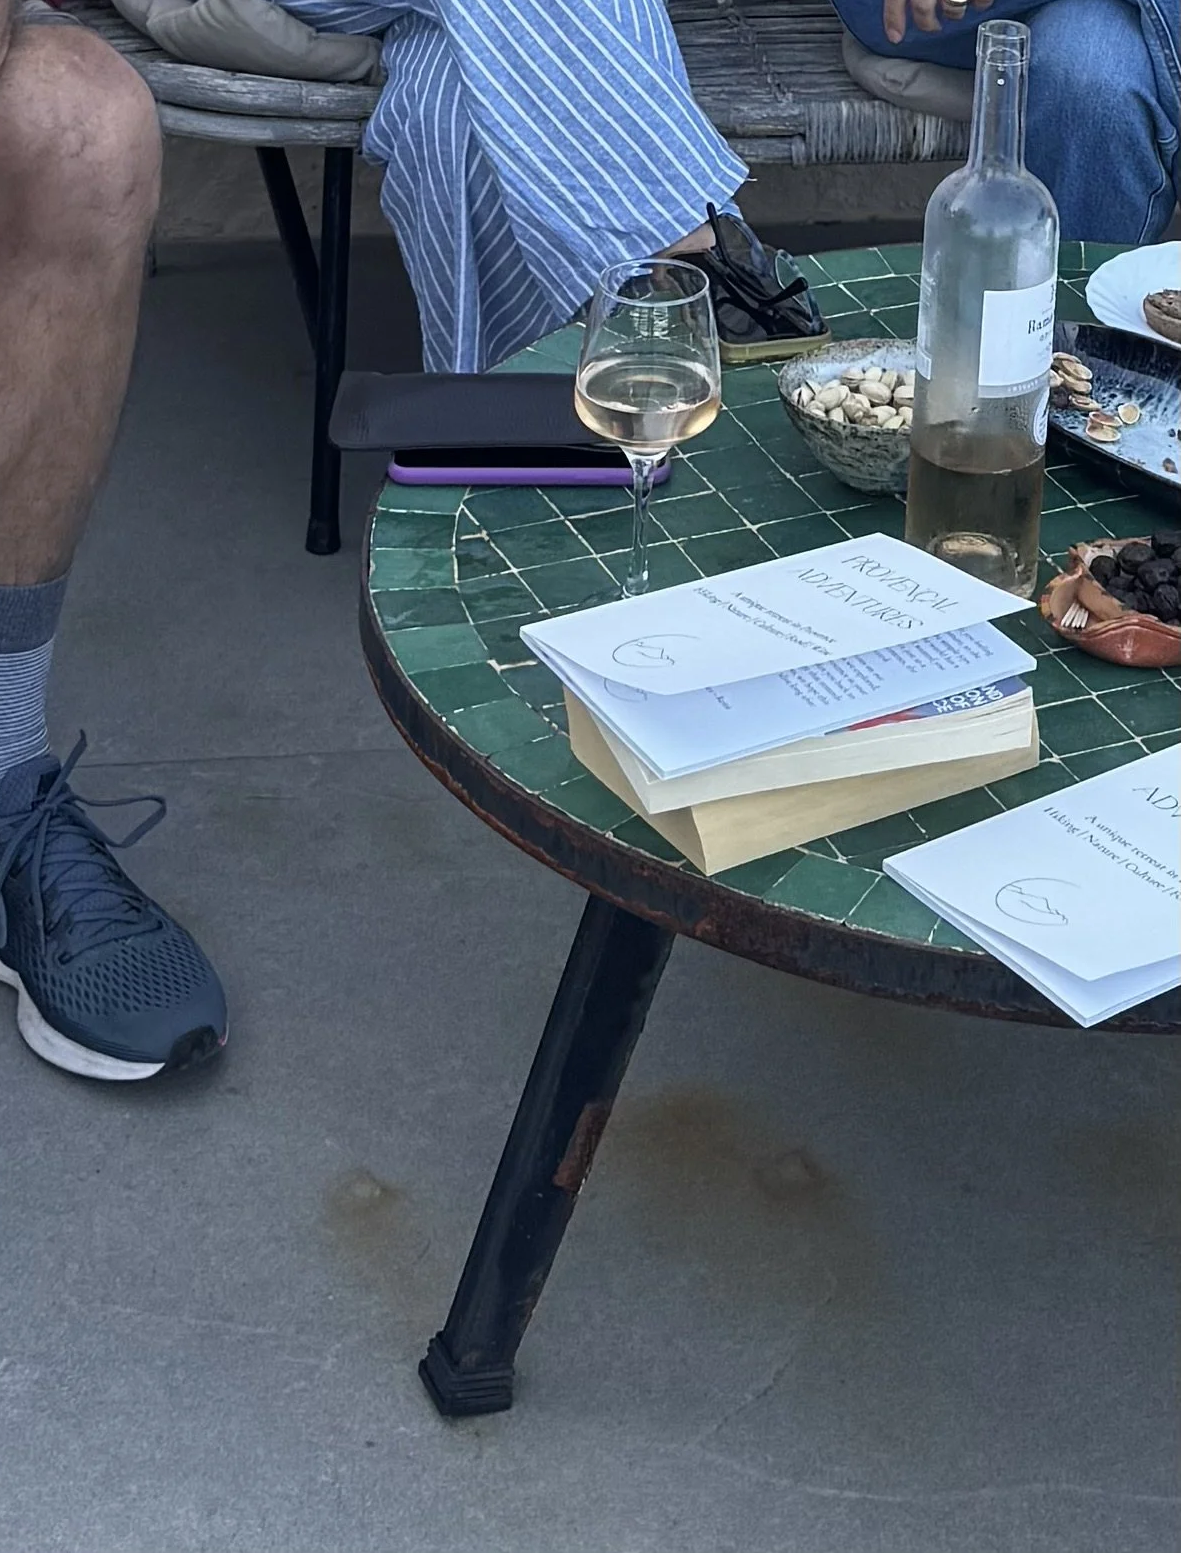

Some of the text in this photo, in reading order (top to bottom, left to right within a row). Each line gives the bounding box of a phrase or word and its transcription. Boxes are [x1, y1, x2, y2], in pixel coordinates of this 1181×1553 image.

[790, 568, 924, 629] ADVENTURES
[841, 555, 959, 614] PROVENÇAL
[1043, 806, 1080, 835] Hiking
[1083, 834, 1121, 861] Nature
[1124, 861, 1165, 889] Culture
[1084, 816, 1098, 824] A
[1095, 823, 1132, 848] unique
[1130, 847, 1167, 871] retreat
